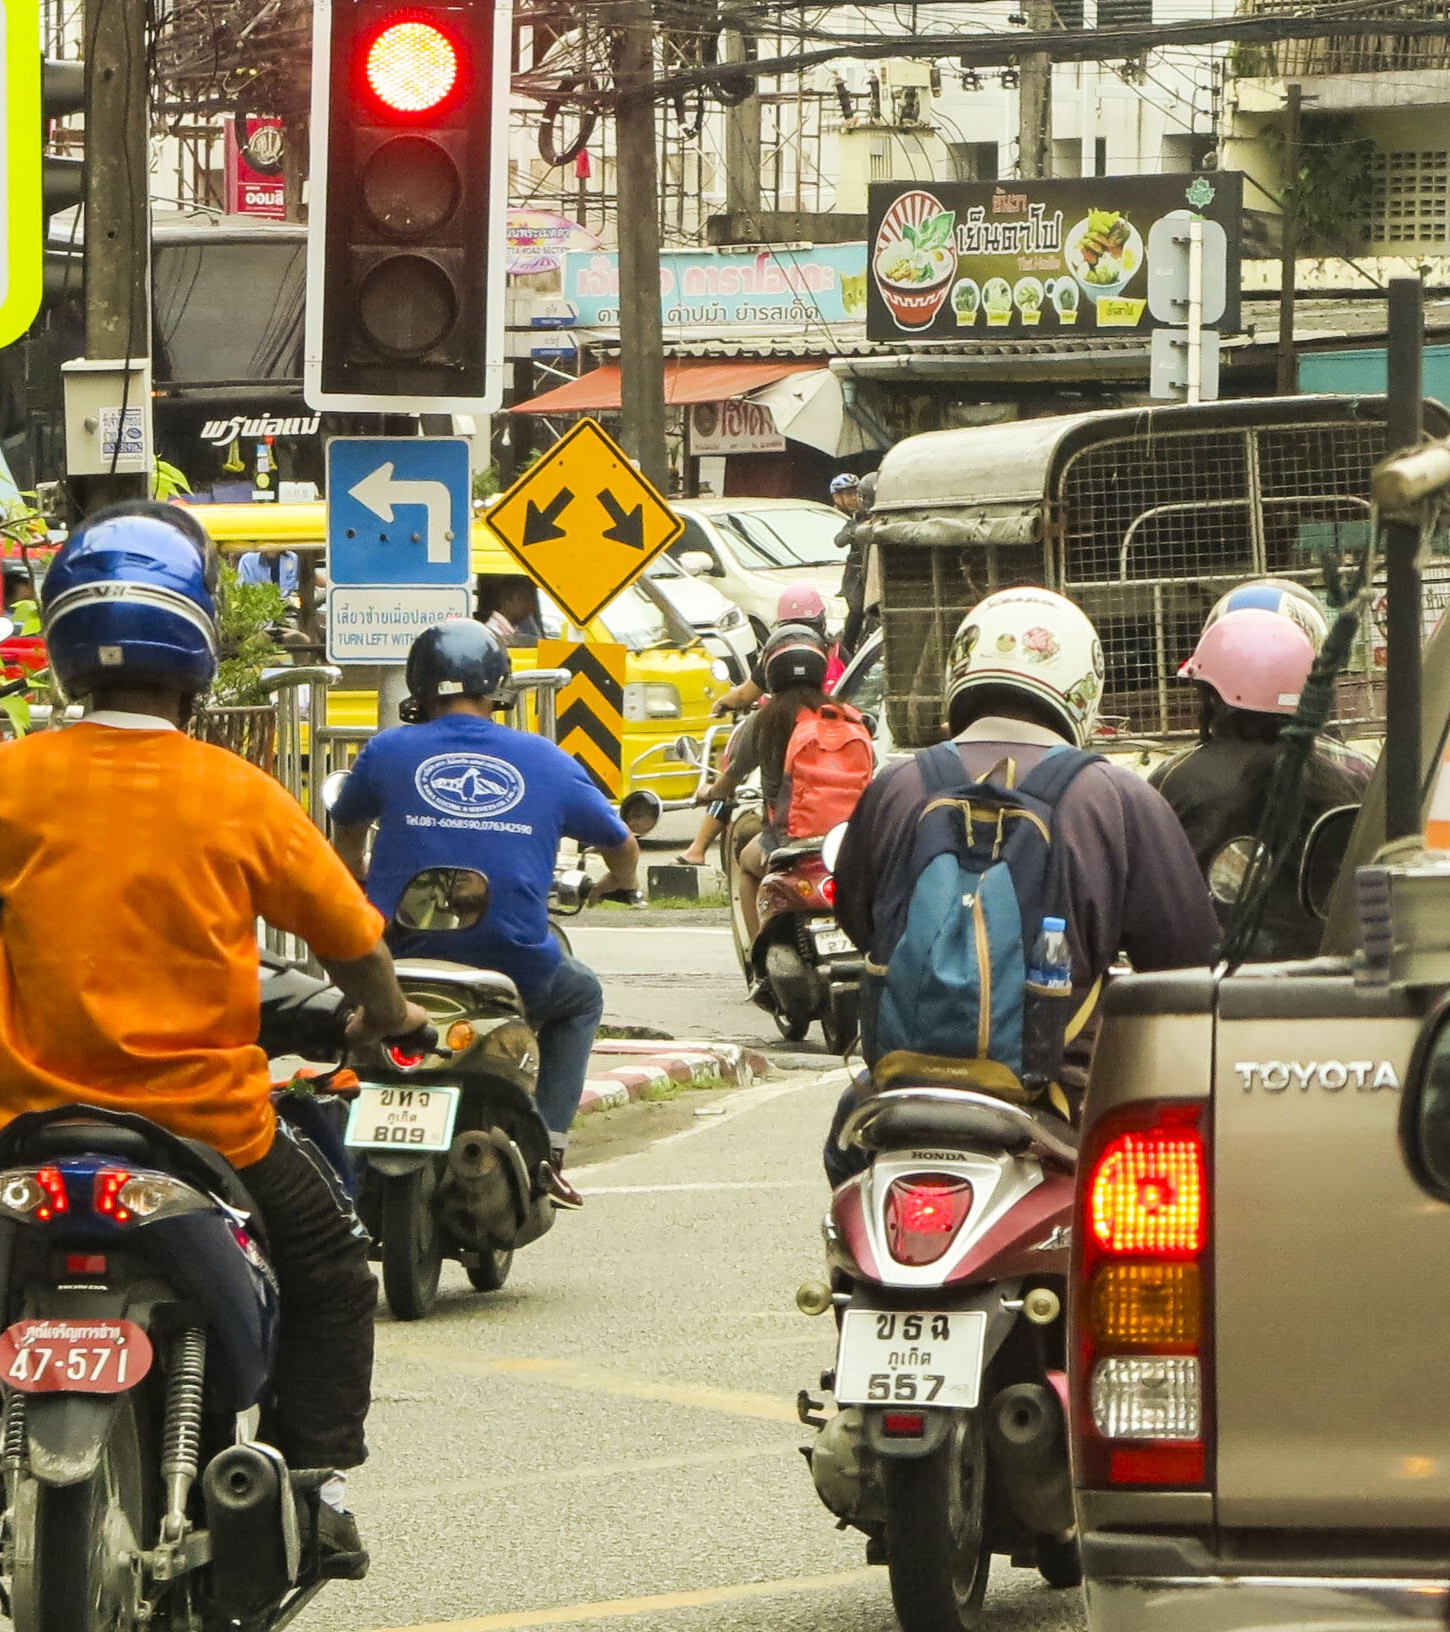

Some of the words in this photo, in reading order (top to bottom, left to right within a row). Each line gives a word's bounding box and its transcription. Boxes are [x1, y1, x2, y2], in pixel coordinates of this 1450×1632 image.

[200, 412, 322, 447] พรพ่อแม่
[338, 633, 364, 645] TURN
[365, 633, 389, 646] LEFT
[1235, 1060, 1400, 1091] TOYOTA
[911, 1150, 968, 1162] HONDA
[867, 1373, 946, 1402] 557
